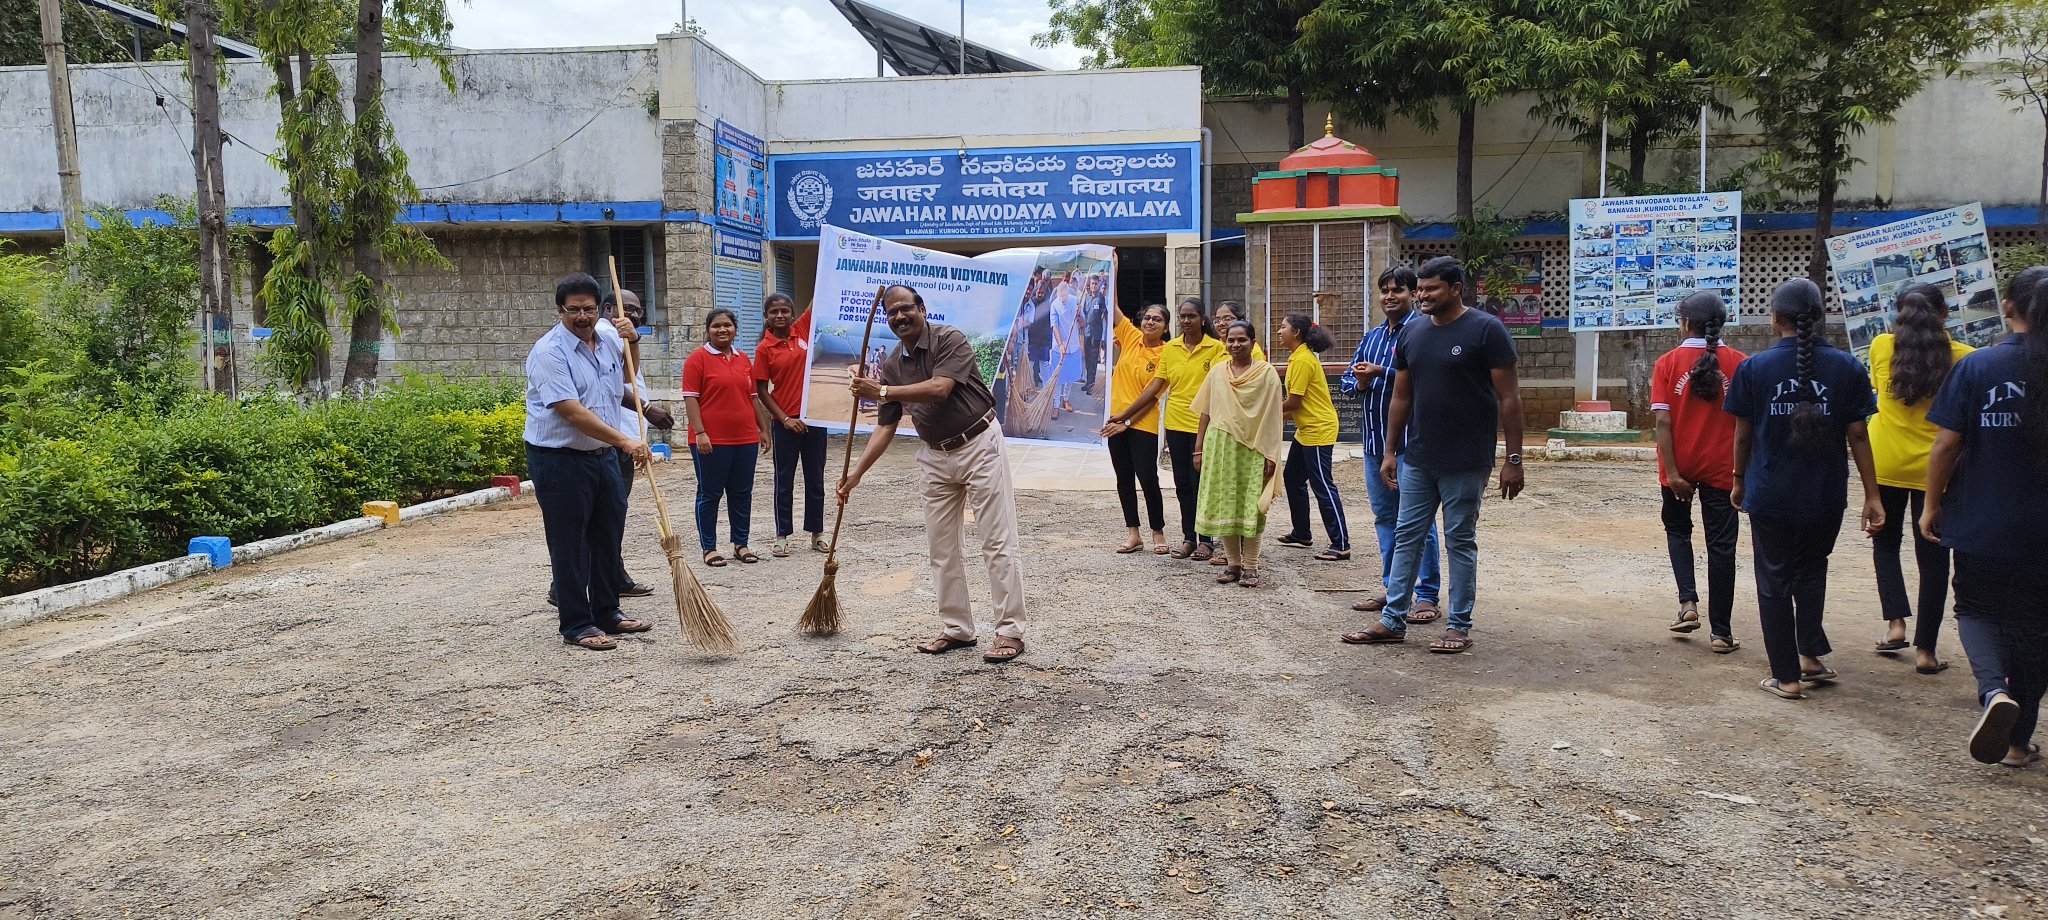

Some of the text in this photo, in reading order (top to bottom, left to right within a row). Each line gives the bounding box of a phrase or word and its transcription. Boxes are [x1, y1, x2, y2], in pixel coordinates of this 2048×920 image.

[960, 155, 1066, 176] నవోదయ
[1075, 152, 1177, 177] విద్యాలయ
[857, 174, 1174, 202] जवाहर नवोदय विद्यालय
[1635, 197, 1671, 205] NAVODAYA
[849, 205, 947, 224] JAWAHAR
[952, 202, 1057, 221] NAVODAYA
[1061, 200, 1182, 219] VIDYALAYA
[1847, 229, 1880, 243] JAWAHAR
[1882, 221, 1918, 234] NAVODAYA
[1901, 238, 1922, 248] GAMES
[1929, 232, 1943, 241] NCC
[1855, 236, 1890, 249] BANAVASI
[836, 258, 1009, 286] JAWAHAR NAVODAYA VIDYALAYA
[938, 282, 954, 292] (Dt)
[858, 307, 882, 315] HOR
